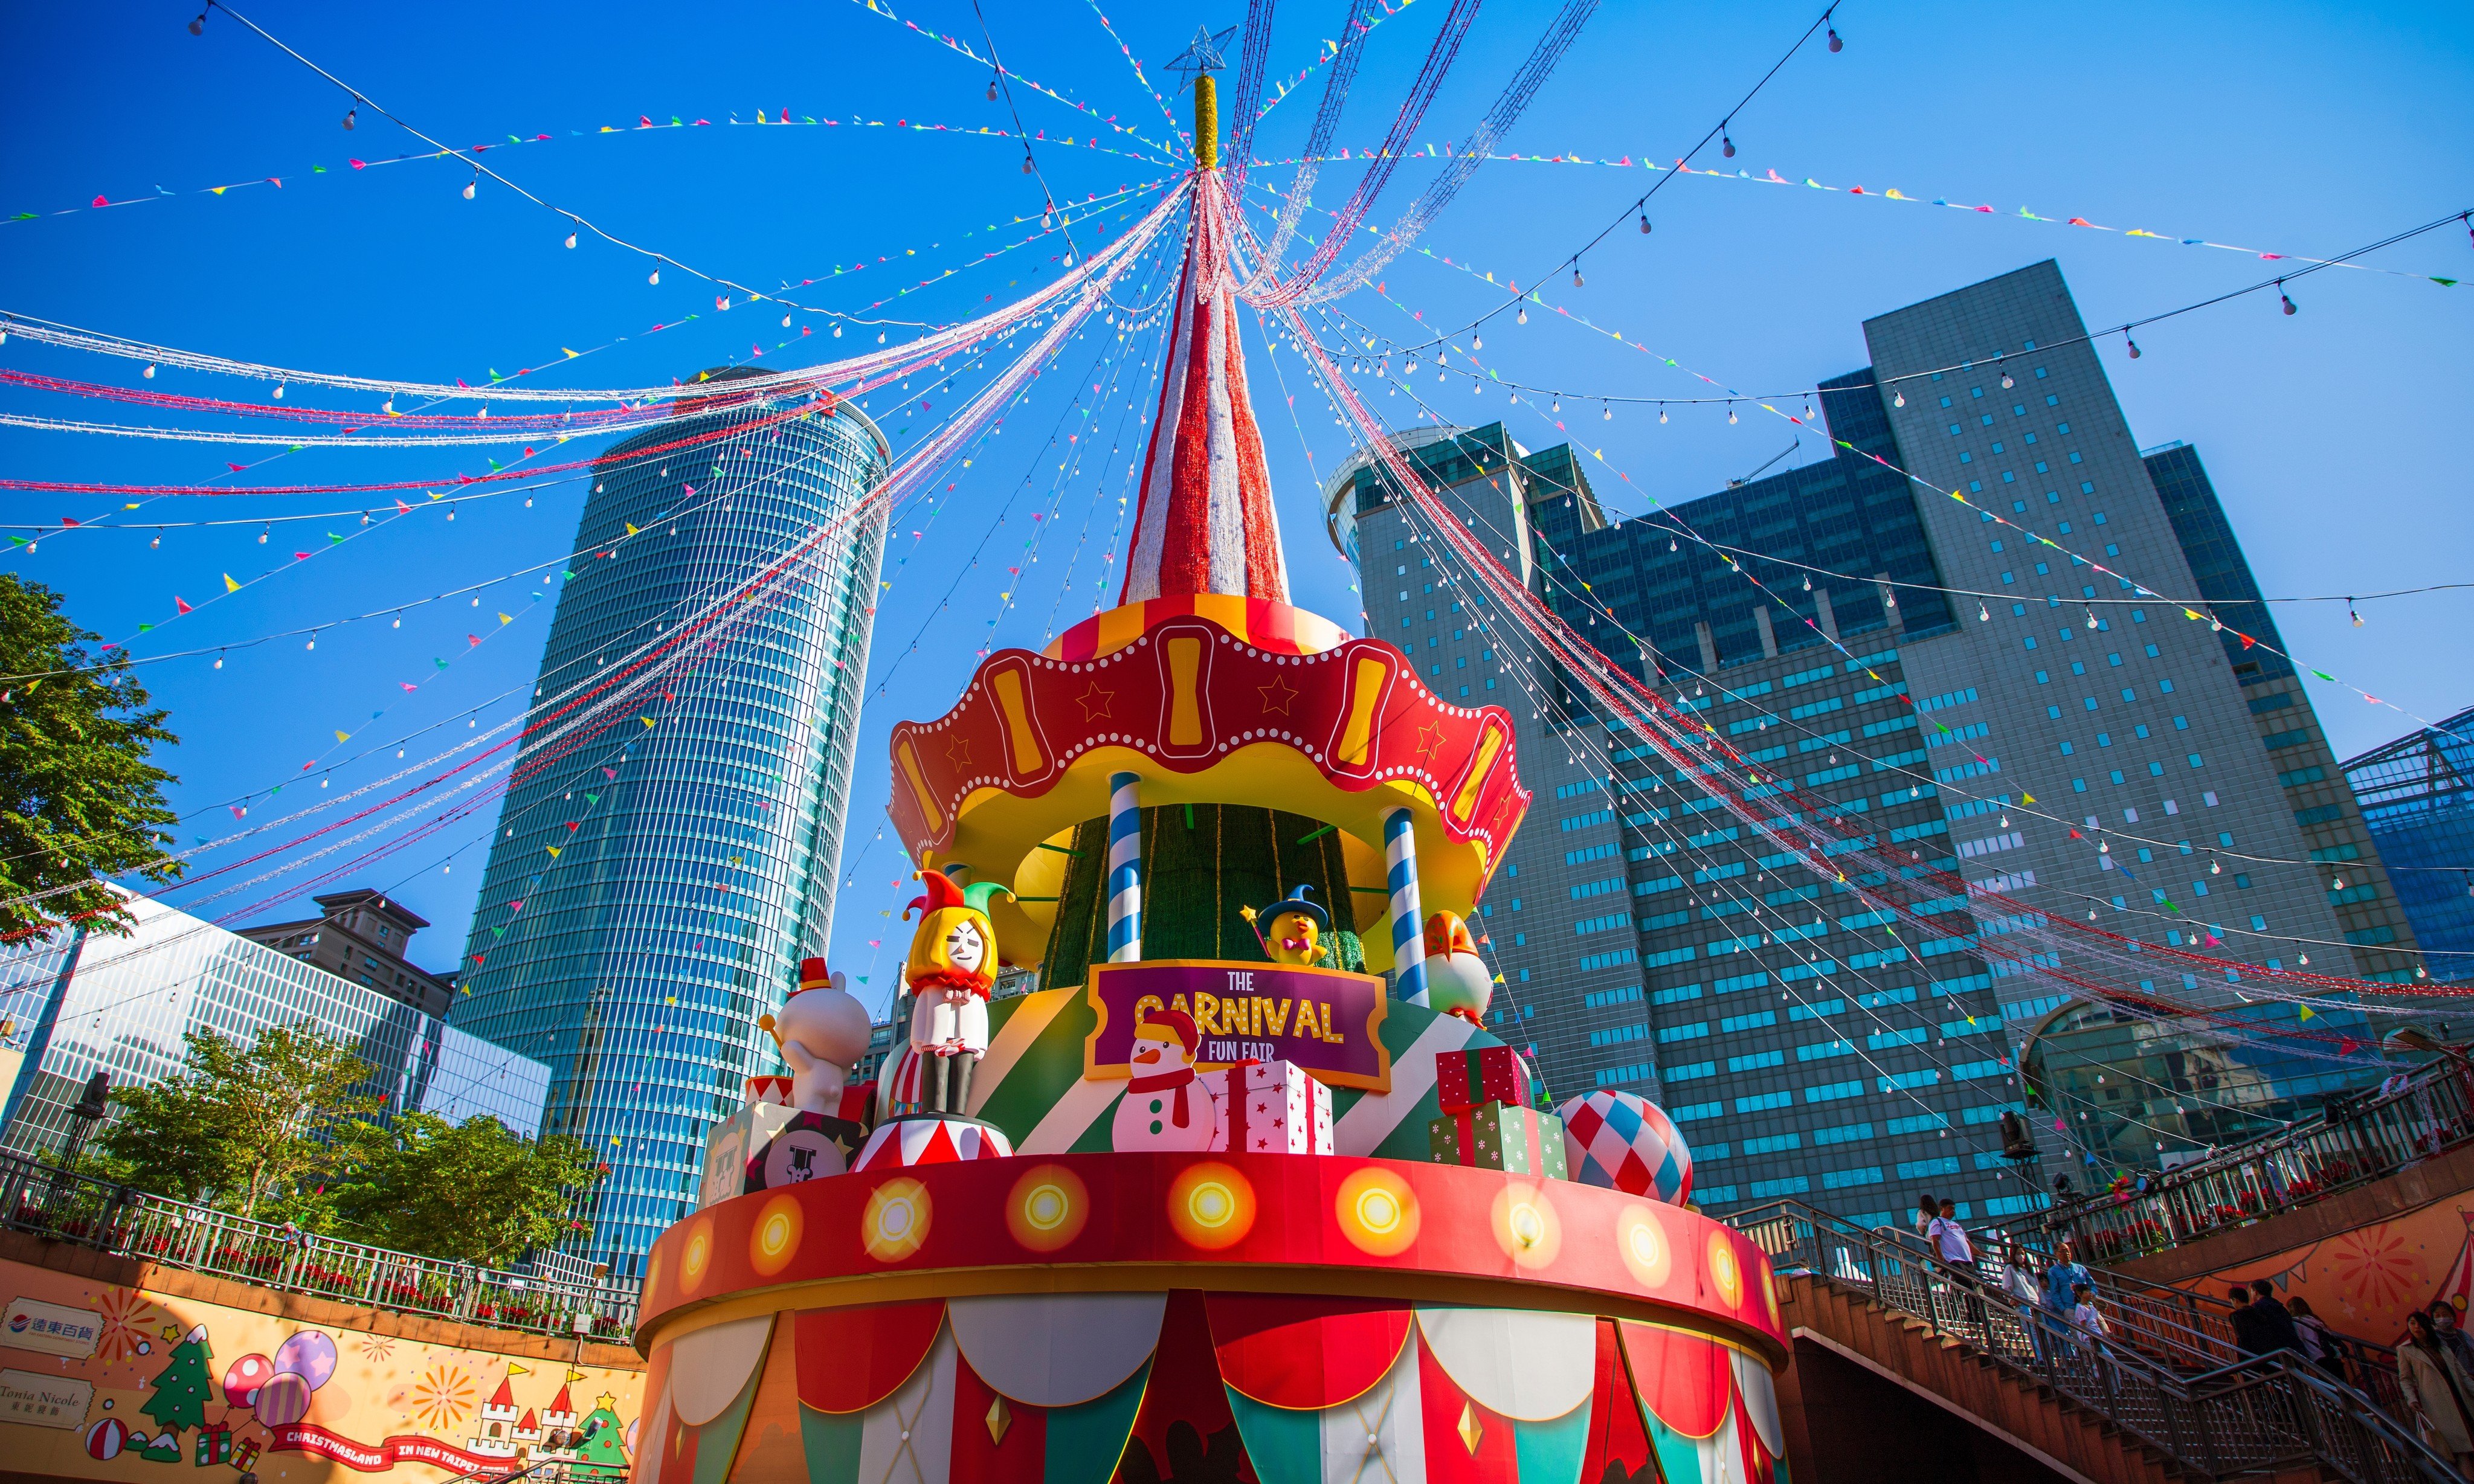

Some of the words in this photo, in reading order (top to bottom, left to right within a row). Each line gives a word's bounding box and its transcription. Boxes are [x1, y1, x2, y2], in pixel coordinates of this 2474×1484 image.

[1227, 971, 1254, 991] THE
[1208, 1041, 1237, 1061] FUN
[1242, 1041, 1275, 1063] FAIR
[31, 1317, 94, 1341] 遠東百貨
[0, 1386, 34, 1400] Tonia
[39, 1391, 79, 1407] Nicole
[286, 1431, 382, 1465] CHRISTMASLAND
[398, 1445, 414, 1456] IN
[415, 1445, 441, 1459] NEW
[441, 1451, 480, 1472] TAIPEI
